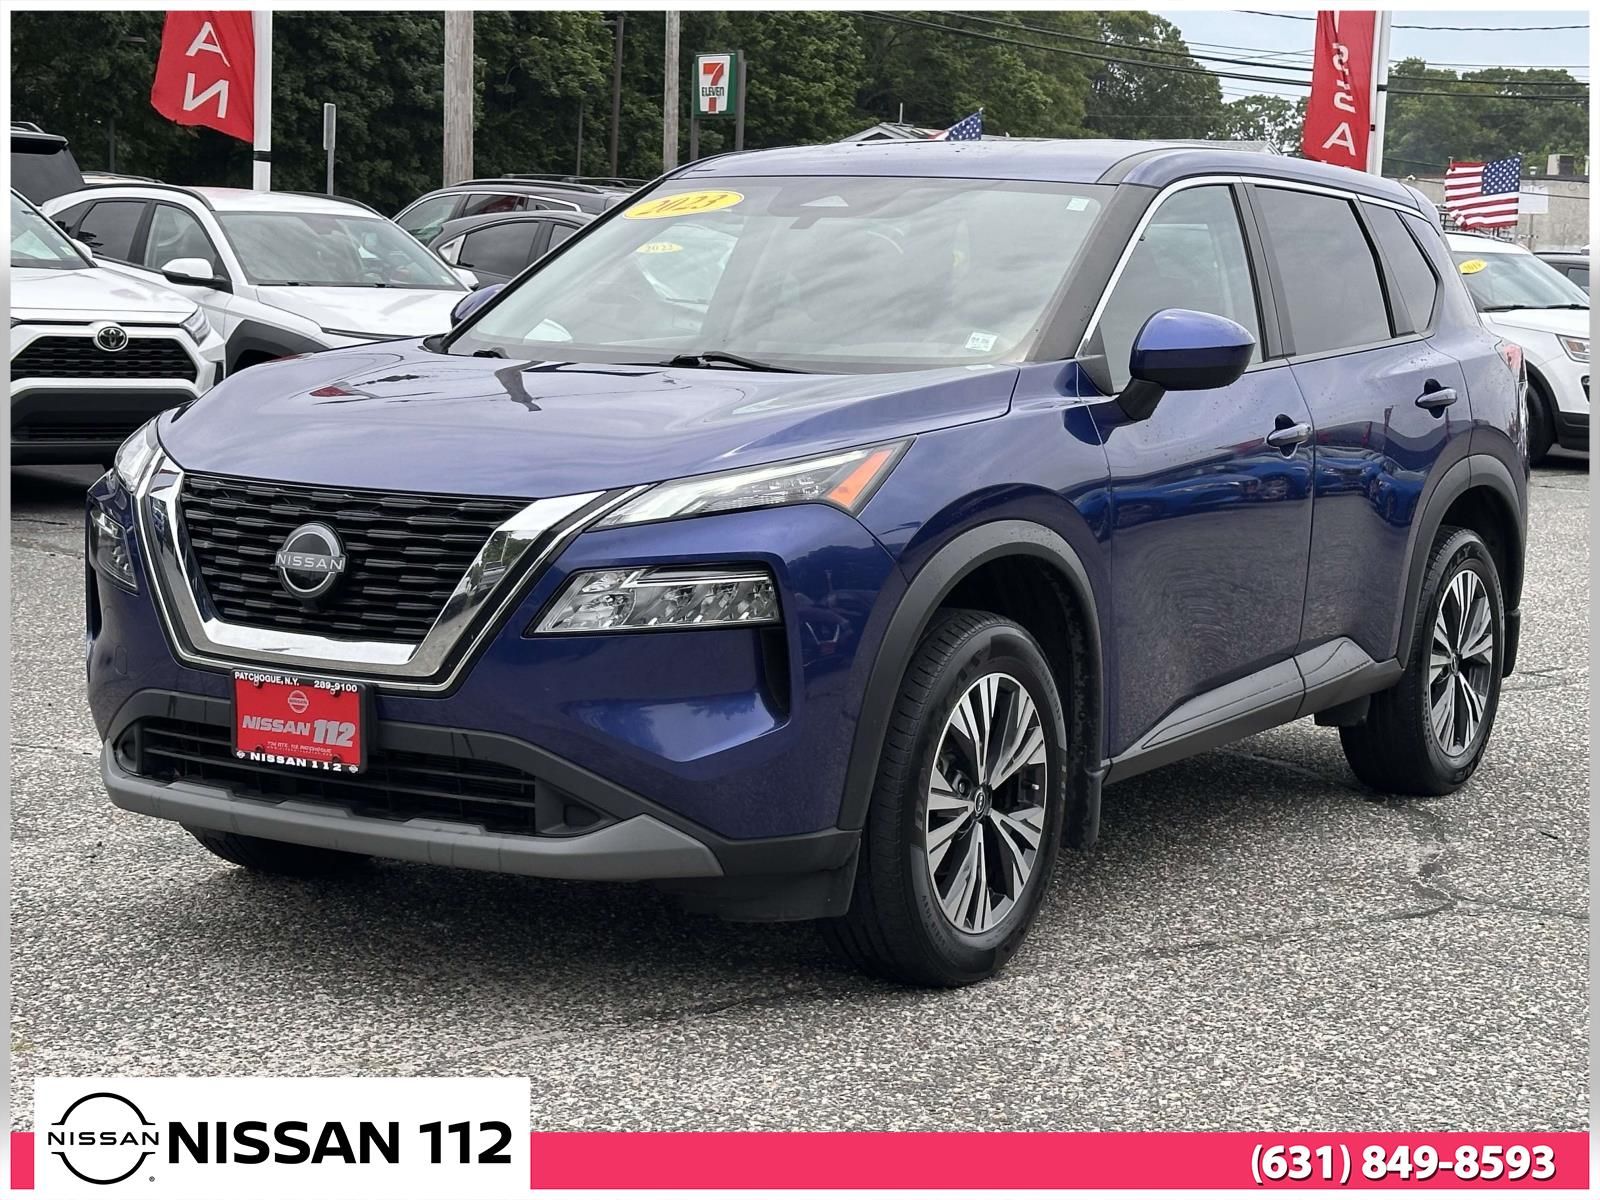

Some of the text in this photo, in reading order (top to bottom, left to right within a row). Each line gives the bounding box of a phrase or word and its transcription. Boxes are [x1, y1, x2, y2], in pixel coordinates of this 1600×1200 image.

[635, 194, 729, 216] 2023
[276, 553, 344, 570] NISSAN
[234, 671, 358, 692] PATCHOGUE, N.Y. 289-9100
[242, 715, 356, 748] NISSAN 112
[250, 751, 307, 767] NISSAN
